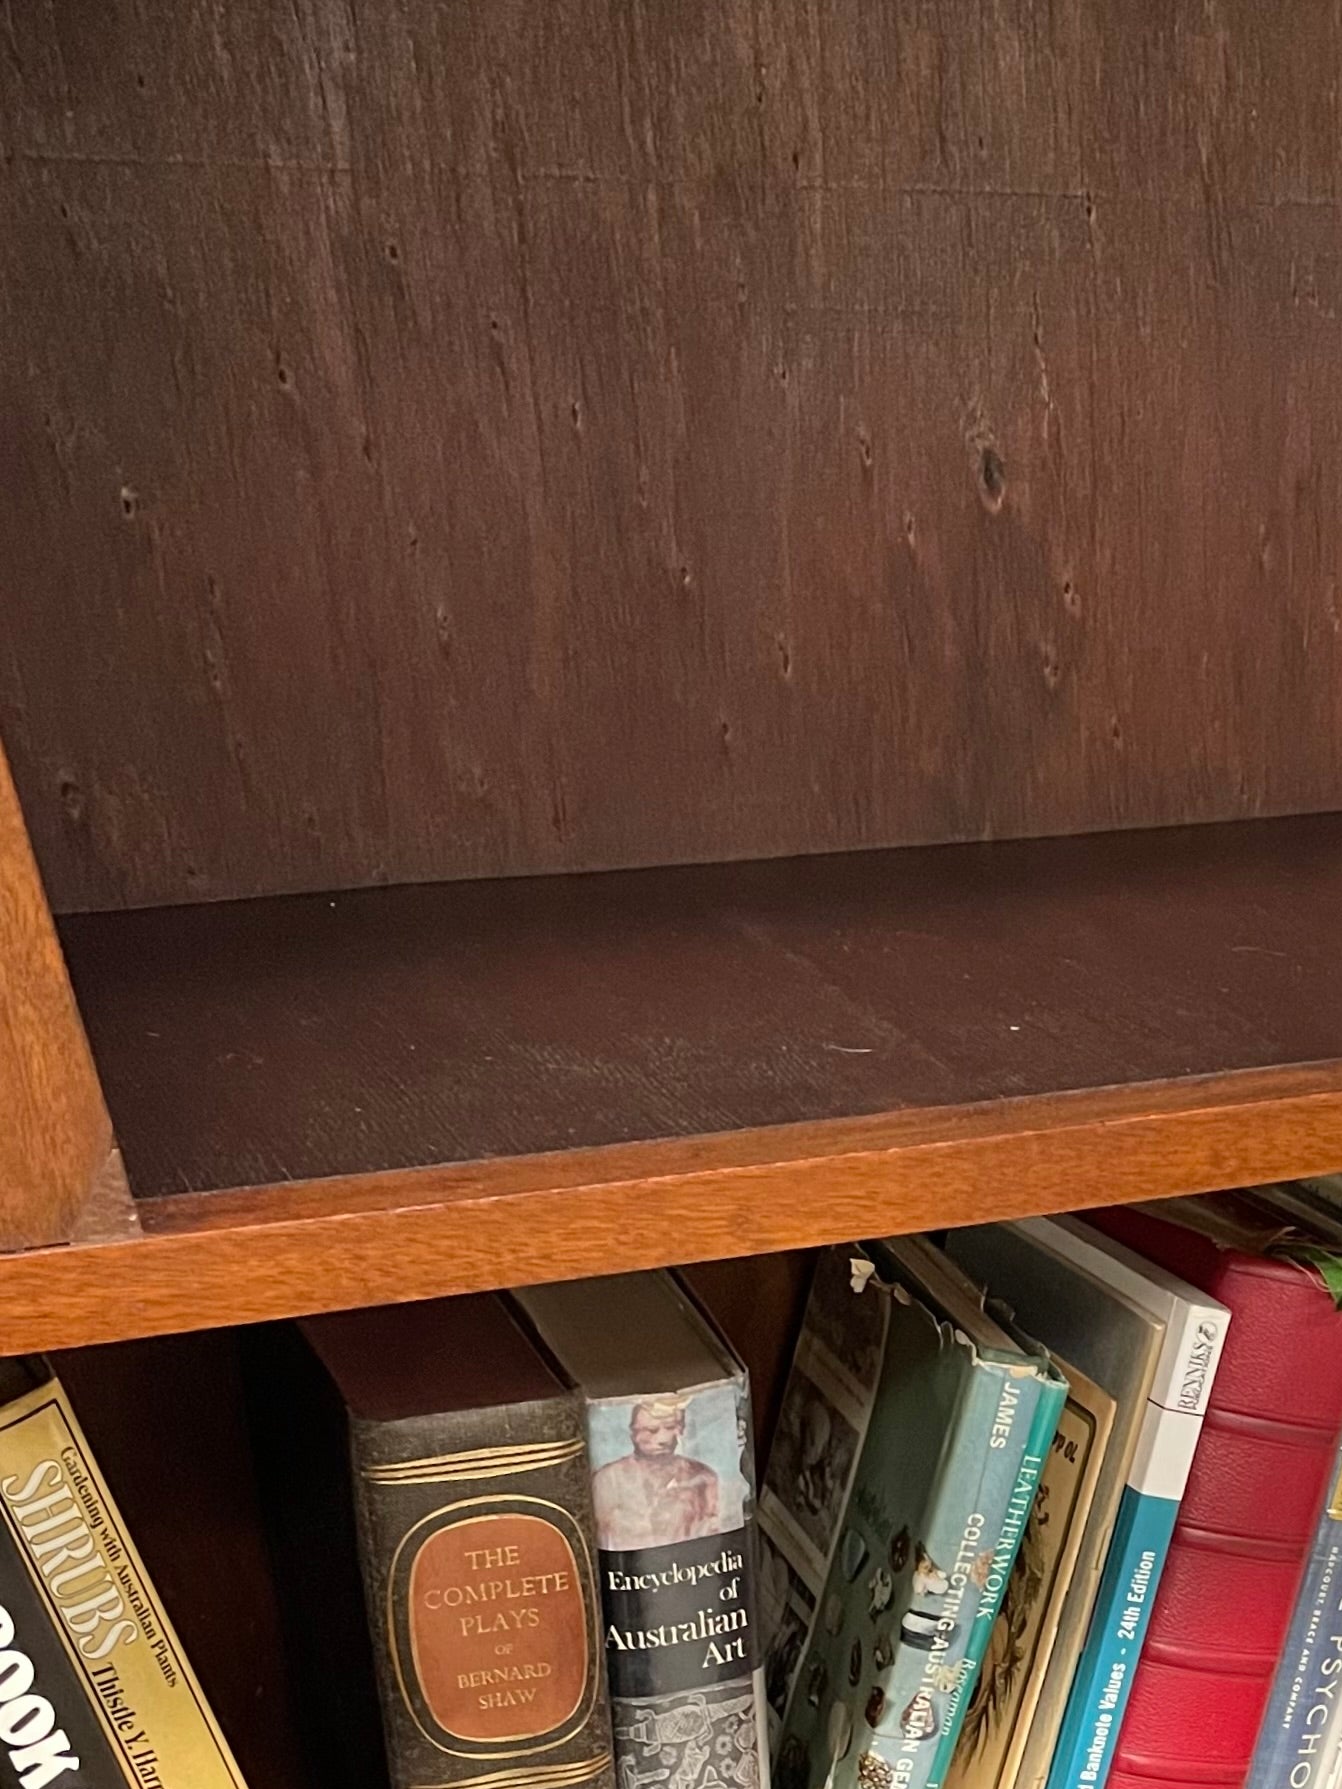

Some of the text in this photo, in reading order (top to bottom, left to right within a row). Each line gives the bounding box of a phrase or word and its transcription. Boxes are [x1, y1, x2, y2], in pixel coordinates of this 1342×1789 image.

[990, 1381, 1021, 1449] JAMES
[60, 1445, 179, 1689] Gardening with Australian Plants
[464, 1545, 521, 1571] THE
[607, 1550, 744, 1593] Encyclopedia
[937, 1513, 985, 1632] COLLECTING
[1127, 1550, 1157, 1603] Edition
[1, 1458, 139, 1661] SHRUBS
[92, 1662, 137, 1732] Thistle
[125, 1730, 149, 1751] Y.
[424, 1571, 569, 1611] COMPLETE
[719, 1577, 741, 1602] of
[460, 1608, 541, 1638] PLAYS
[604, 1606, 749, 1652] Australian
[1117, 1605, 1142, 1640] 24th
[494, 1642, 515, 1657] OF
[701, 1637, 747, 1669] Art
[1298, 1648, 1311, 1672] AND
[457, 1662, 553, 1690] BERNARD
[902, 1636, 950, 1753] AUSTRALIAN
[1098, 1663, 1126, 1710] Values
[478, 1687, 538, 1711] SHAW
[1282, 1676, 1304, 1729] COMPANY
[1079, 1707, 1114, 1782] Banknote
